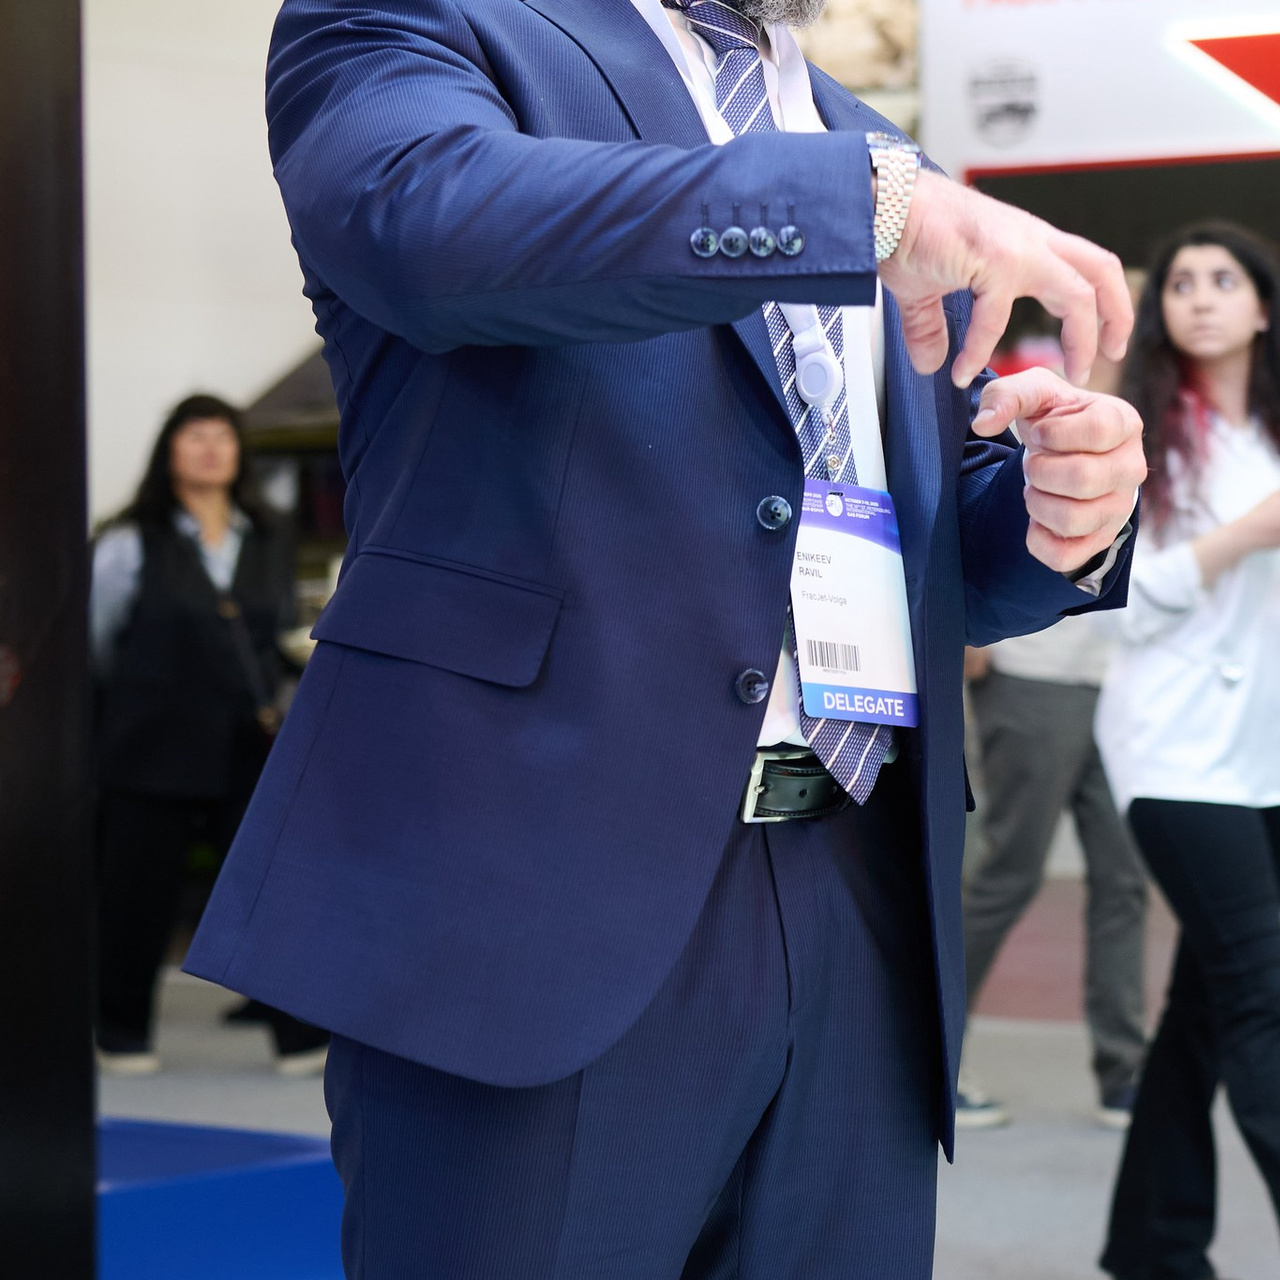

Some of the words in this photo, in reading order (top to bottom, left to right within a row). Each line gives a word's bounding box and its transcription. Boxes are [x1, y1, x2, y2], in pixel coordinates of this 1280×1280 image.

[796, 551, 832, 564] ENIKEEV
[799, 566, 823, 578] RAVIL
[823, 691, 905, 717] DELEGATE
